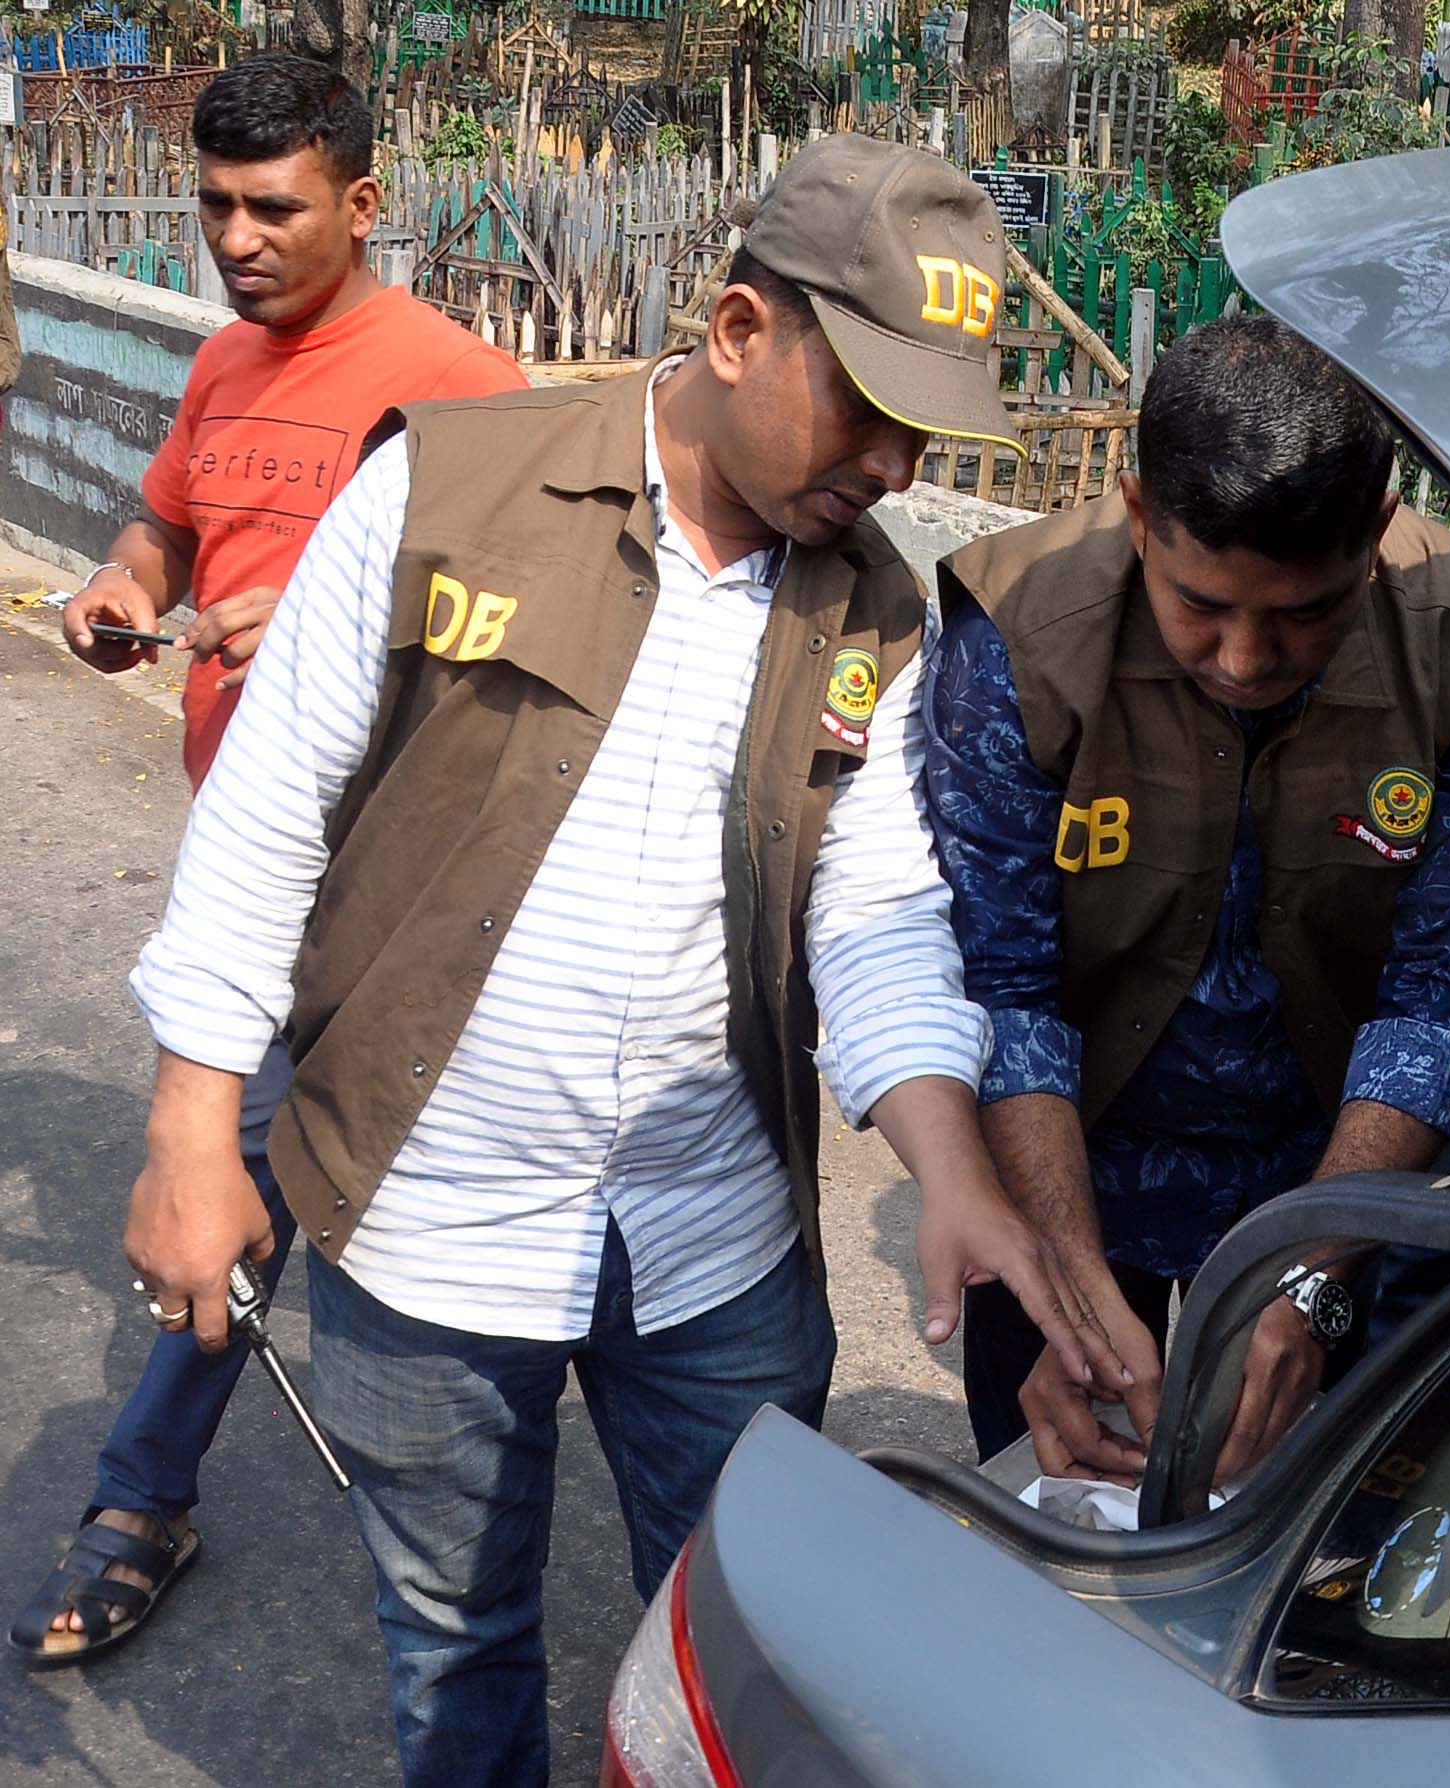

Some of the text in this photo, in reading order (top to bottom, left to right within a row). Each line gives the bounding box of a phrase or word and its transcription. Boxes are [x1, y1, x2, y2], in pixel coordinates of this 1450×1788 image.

[915, 254, 1000, 337] DB
[424, 571, 518, 661] DB
[1054, 796, 1130, 873] DB
